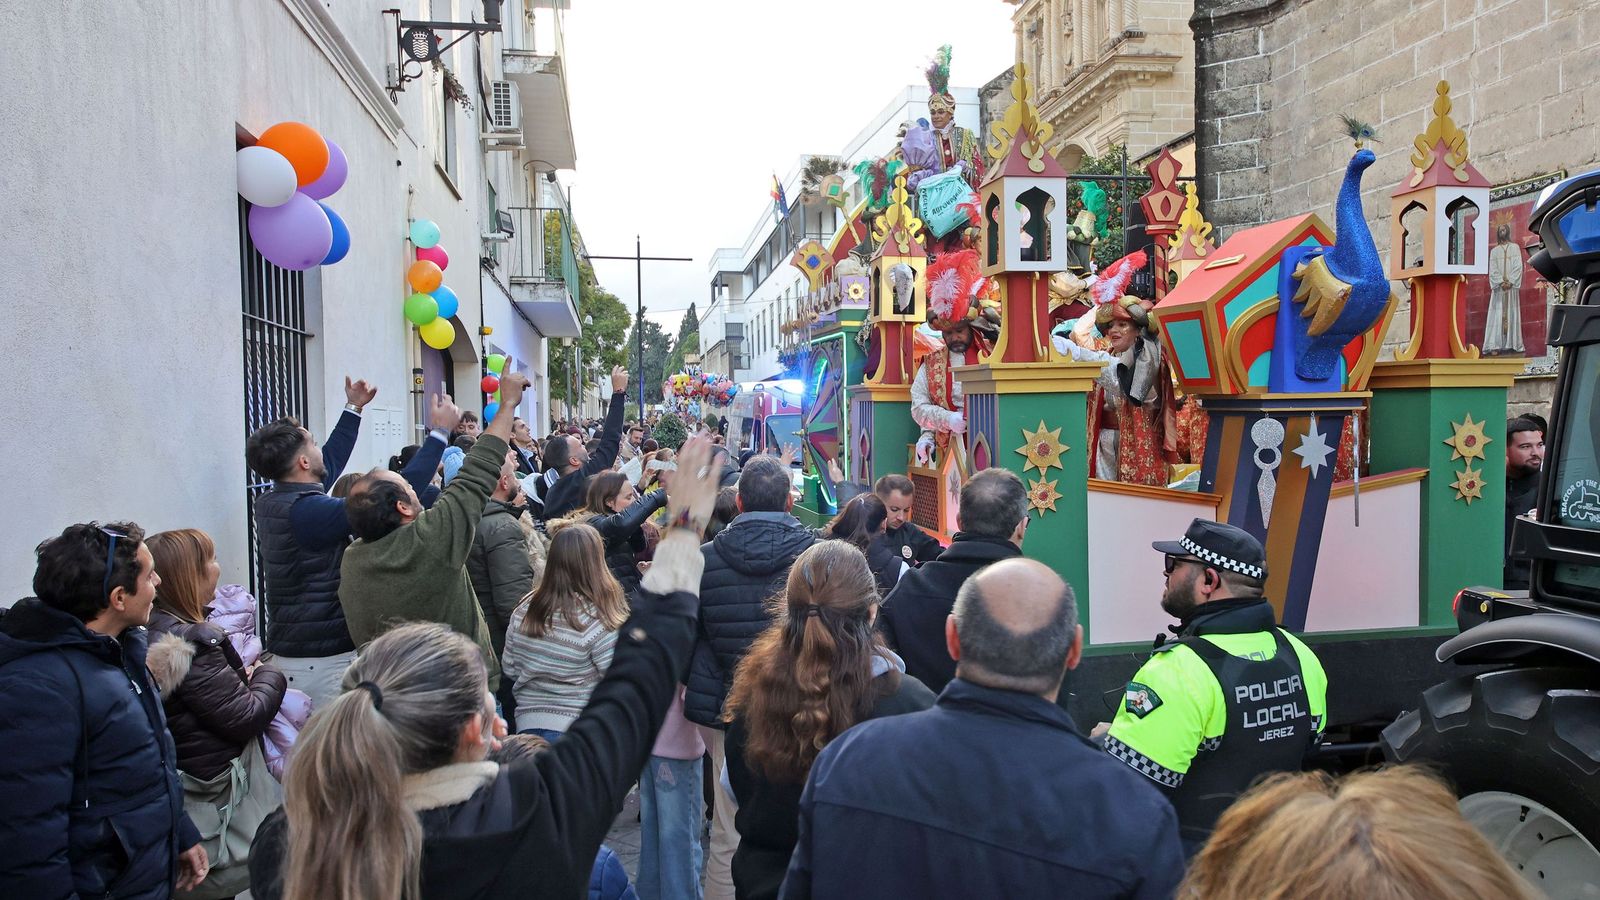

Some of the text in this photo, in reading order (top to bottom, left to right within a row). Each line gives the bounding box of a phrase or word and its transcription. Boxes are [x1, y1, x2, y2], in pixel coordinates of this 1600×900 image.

[1561, 484, 1576, 517] TRACTOR
[1585, 479, 1598, 489] THE
[1235, 674, 1302, 704] POLICIA
[1243, 702, 1306, 728] LOCAL
[1258, 726, 1294, 742] JEREZ
